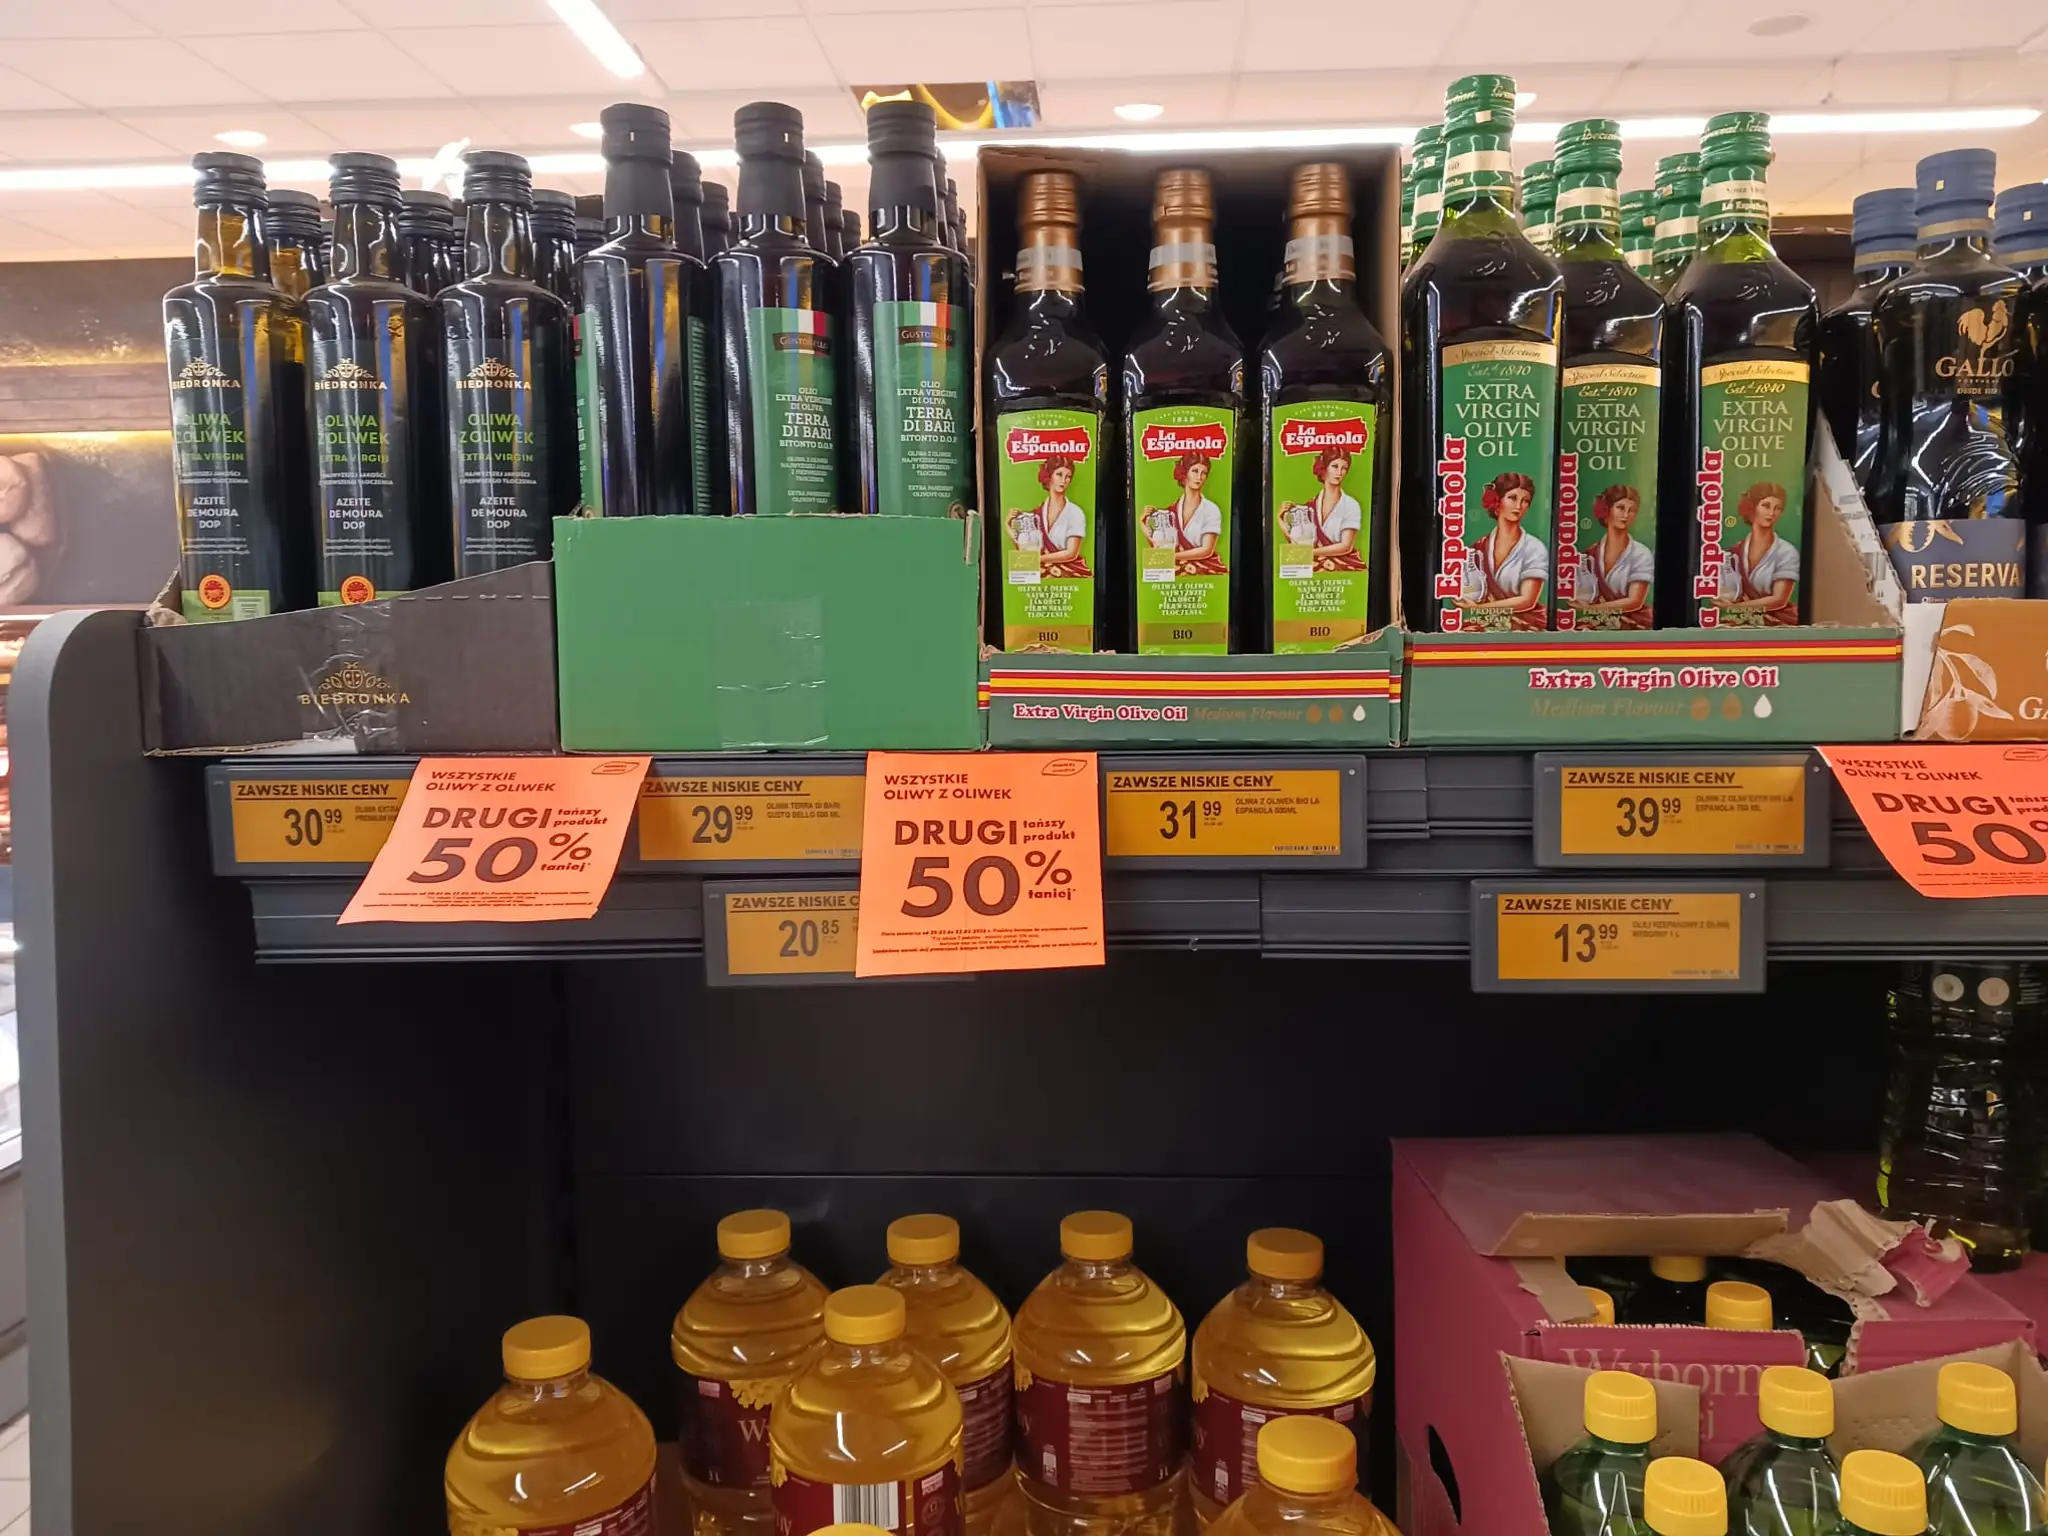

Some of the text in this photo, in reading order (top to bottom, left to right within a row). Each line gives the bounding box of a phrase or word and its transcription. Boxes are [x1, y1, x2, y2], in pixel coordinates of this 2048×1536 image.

[1935, 357, 2014, 377] GALLO
[172, 380, 241, 389] BIEDRONKA
[314, 380, 388, 390] BIEDRONKA
[456, 380, 532, 389] BIEDRONKA
[1755, 383, 1785, 393] 1840
[897, 388, 924, 396] EXTRA
[1464, 384, 1535, 399] EXTRA
[923, 397, 946, 405] OLIVA
[906, 407, 953, 420] TERRA
[1455, 402, 1540, 418] VIRGIN
[1577, 403, 1640, 418] EXTRA
[1722, 400, 1788, 416] EXTRA
[325, 414, 378, 427] OLIWA
[467, 413, 523, 427] OLIWA
[785, 412, 829, 426] TERRA
[1714, 418, 1793, 432] VIRGIN
[782, 425, 831, 440] DI BARI
[903, 420, 956, 433] DI BARI
[1298, 425, 1316, 435] La
[1465, 421, 1532, 438] OLIVE
[1568, 420, 1646, 435] VIRGIN
[326, 431, 390, 445] OLIWEK
[460, 431, 534, 444] Z OLIWEK
[900, 434, 939, 442] BITONTO
[1022, 433, 1040, 443] La
[1158, 430, 1176, 440] La
[1285, 431, 1363, 447] Española
[1011, 440, 1086, 455] Española
[1146, 436, 1223, 452] Española
[1478, 441, 1519, 457] OIL
[1577, 438, 1638, 453] OLIVE
[1722, 435, 1784, 450] OLIVE
[494, 453, 533, 462] VIRGIN
[1589, 456, 1626, 470] OIL
[1735, 453, 1771, 468] OIL
[193, 496, 226, 505] AZEITE
[336, 498, 371, 506] AZEITE
[479, 497, 515, 505] AZEITE
[187, 508, 239, 517] DE MOURA
[329, 510, 383, 518] DE MOURA
[471, 508, 527, 517] DE MOURA
[1435, 433, 1471, 599] Española
[199, 520, 221, 529] DOP
[343, 521, 366, 529] DOP
[487, 520, 510, 529] DOP
[1694, 446, 1725, 599] Española
[1911, 562, 2022, 589] RESERVA
[1470, 607, 1513, 615] PRODUCT
[1485, 615, 1510, 623] SPAIN
[1039, 632, 1058, 641] BIO
[1173, 630, 1192, 639] BIO
[1310, 627, 1330, 636] BIO
[1529, 665, 1780, 692] Extra Virgin Olive Oil
[300, 692, 410, 705] BIEDRONKA
[1014, 703, 1059, 719] Extra
[1061, 704, 1114, 722] Virgin
[1116, 706, 1160, 720] Olive
[1162, 706, 1188, 721] Oil
[1836, 758, 1927, 769] WSZYSTKIE
[431, 771, 516, 781] WSZYSTKIE
[884, 774, 969, 785] WSZYSTKIE
[1568, 772, 1735, 784] ZAWSZE NISKIE CENY
[1844, 768, 1983, 781] OLIWY Z OLIWEK
[426, 782, 556, 791] OLIWY Z OLIWEK
[645, 780, 803, 793] ZAWSZE NISKIE CENY
[1113, 776, 1273, 787] ZAWSZE NISKIE CENY
[238, 784, 389, 796] ZAWSZE NISKIE CENY
[884, 788, 1012, 800] OLIWY Z OLIWEK
[1872, 792, 2013, 816] DRUGI
[422, 806, 602, 829] DRUGI tańszy
[553, 817, 608, 827] produkt
[1159, 801, 1221, 839] 31 99
[1616, 797, 1681, 837] 39 99
[283, 808, 342, 846] 30 99
[692, 805, 753, 843] 29 99
[894, 818, 1065, 845] DRUGI tańszy
[1023, 831, 1076, 844] produkt
[733, 897, 795, 908] ZAWSZE
[799, 896, 845, 907] NISKIE
[1505, 898, 1673, 911] ZAWSZE NISKIE CENY
[779, 920, 839, 957] 20 85
[1554, 924, 1596, 963] 13
[1599, 924, 1618, 939] 99
